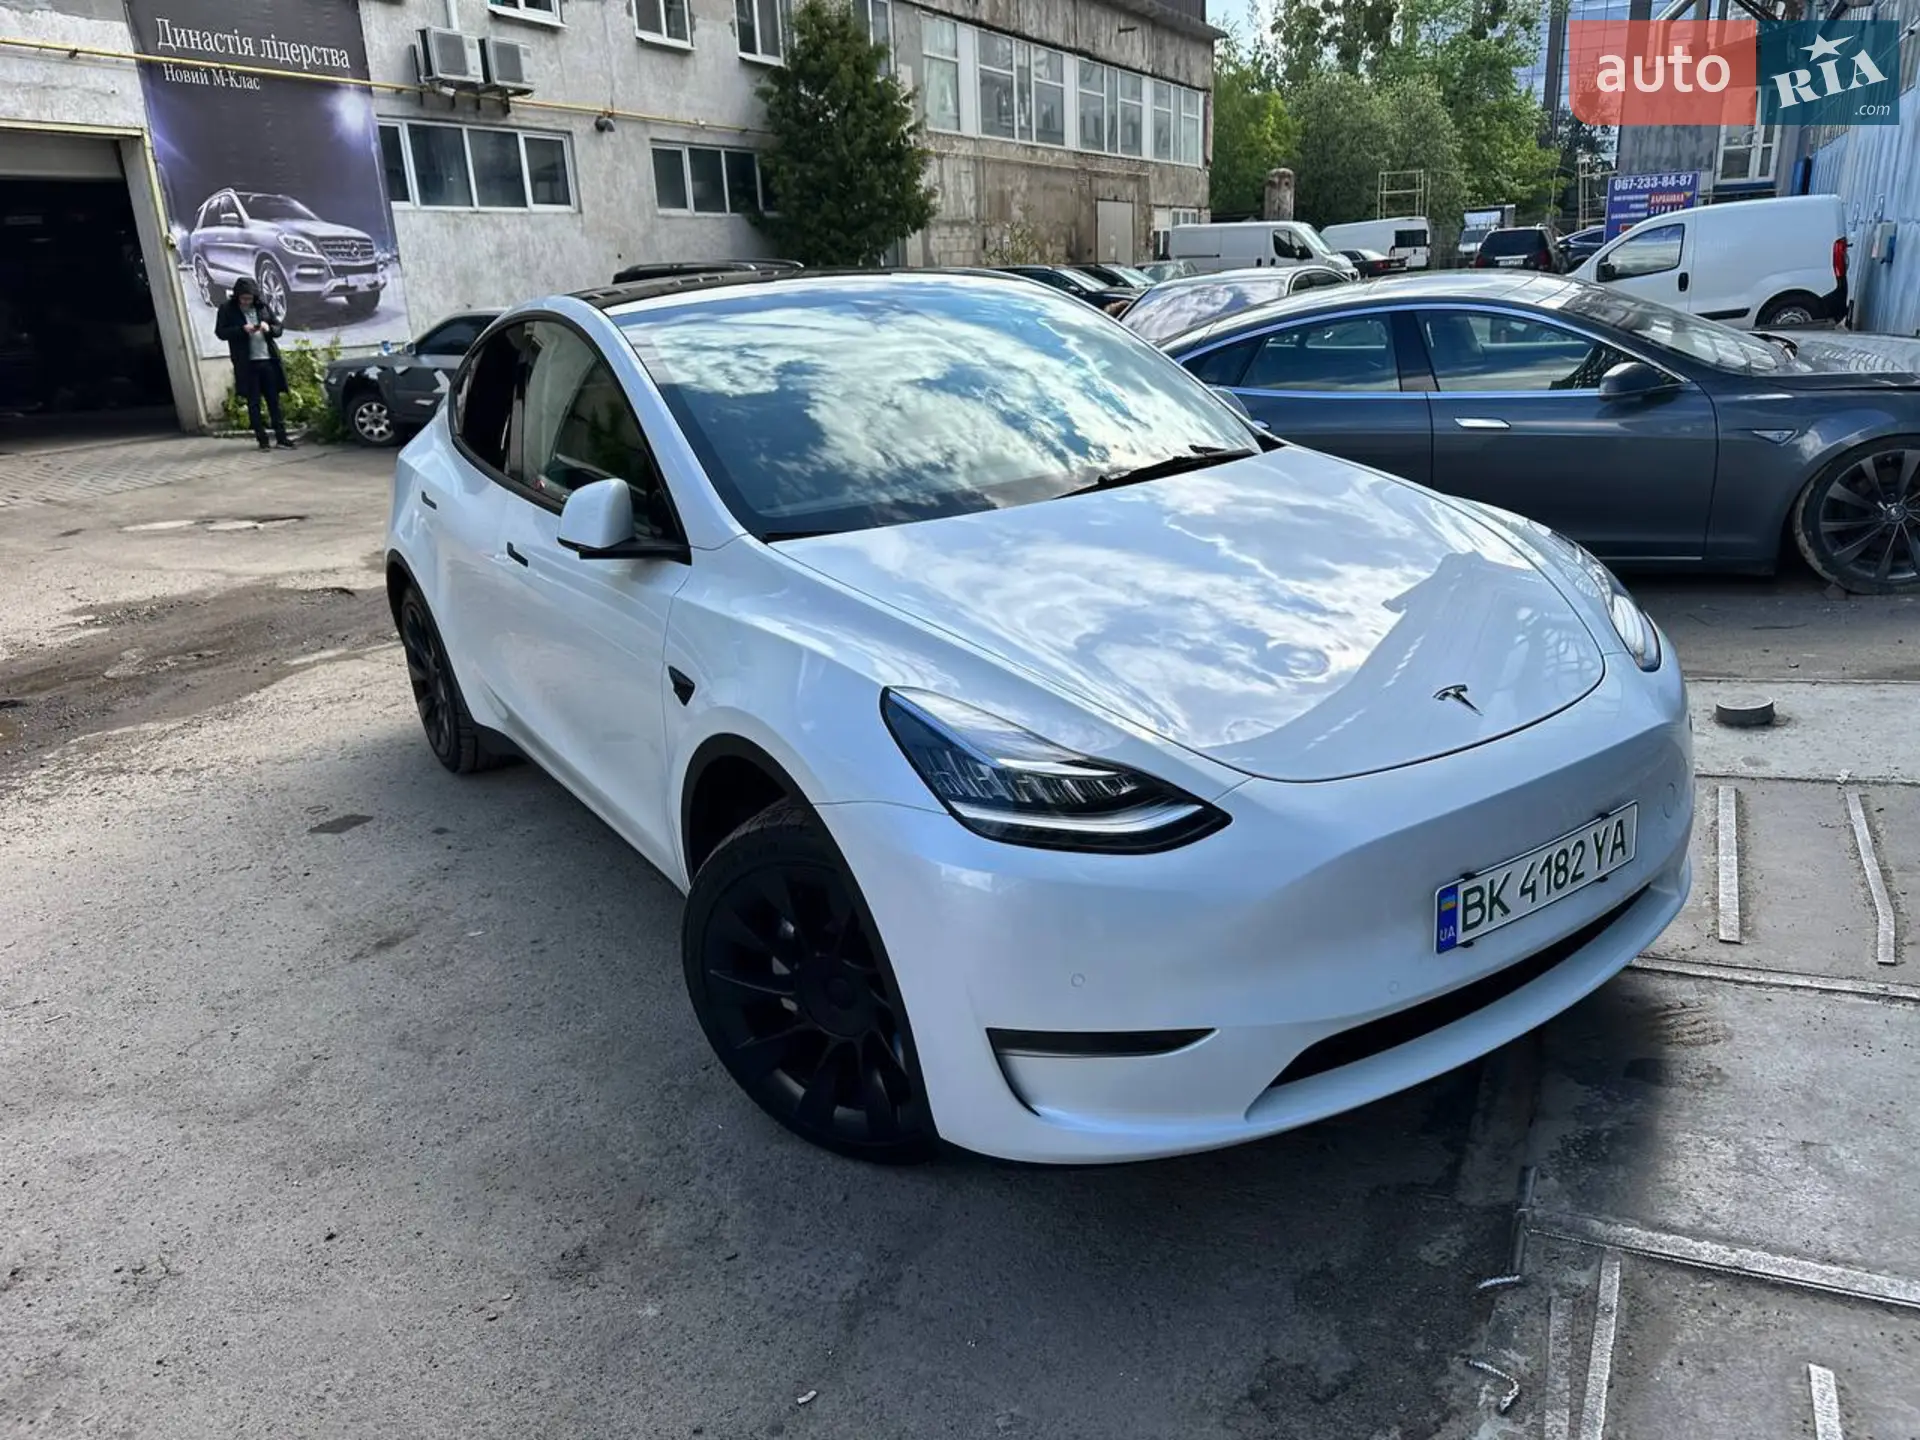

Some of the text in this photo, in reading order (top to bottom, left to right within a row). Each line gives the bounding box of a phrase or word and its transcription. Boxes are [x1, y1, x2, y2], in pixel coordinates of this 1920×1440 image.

[156, 17, 350, 70] Династія лідерства
[163, 63, 260, 91] Новий М-Клас
[1462, 819, 1627, 932] BK 4182 YA
[1439, 925, 1457, 942] UA
